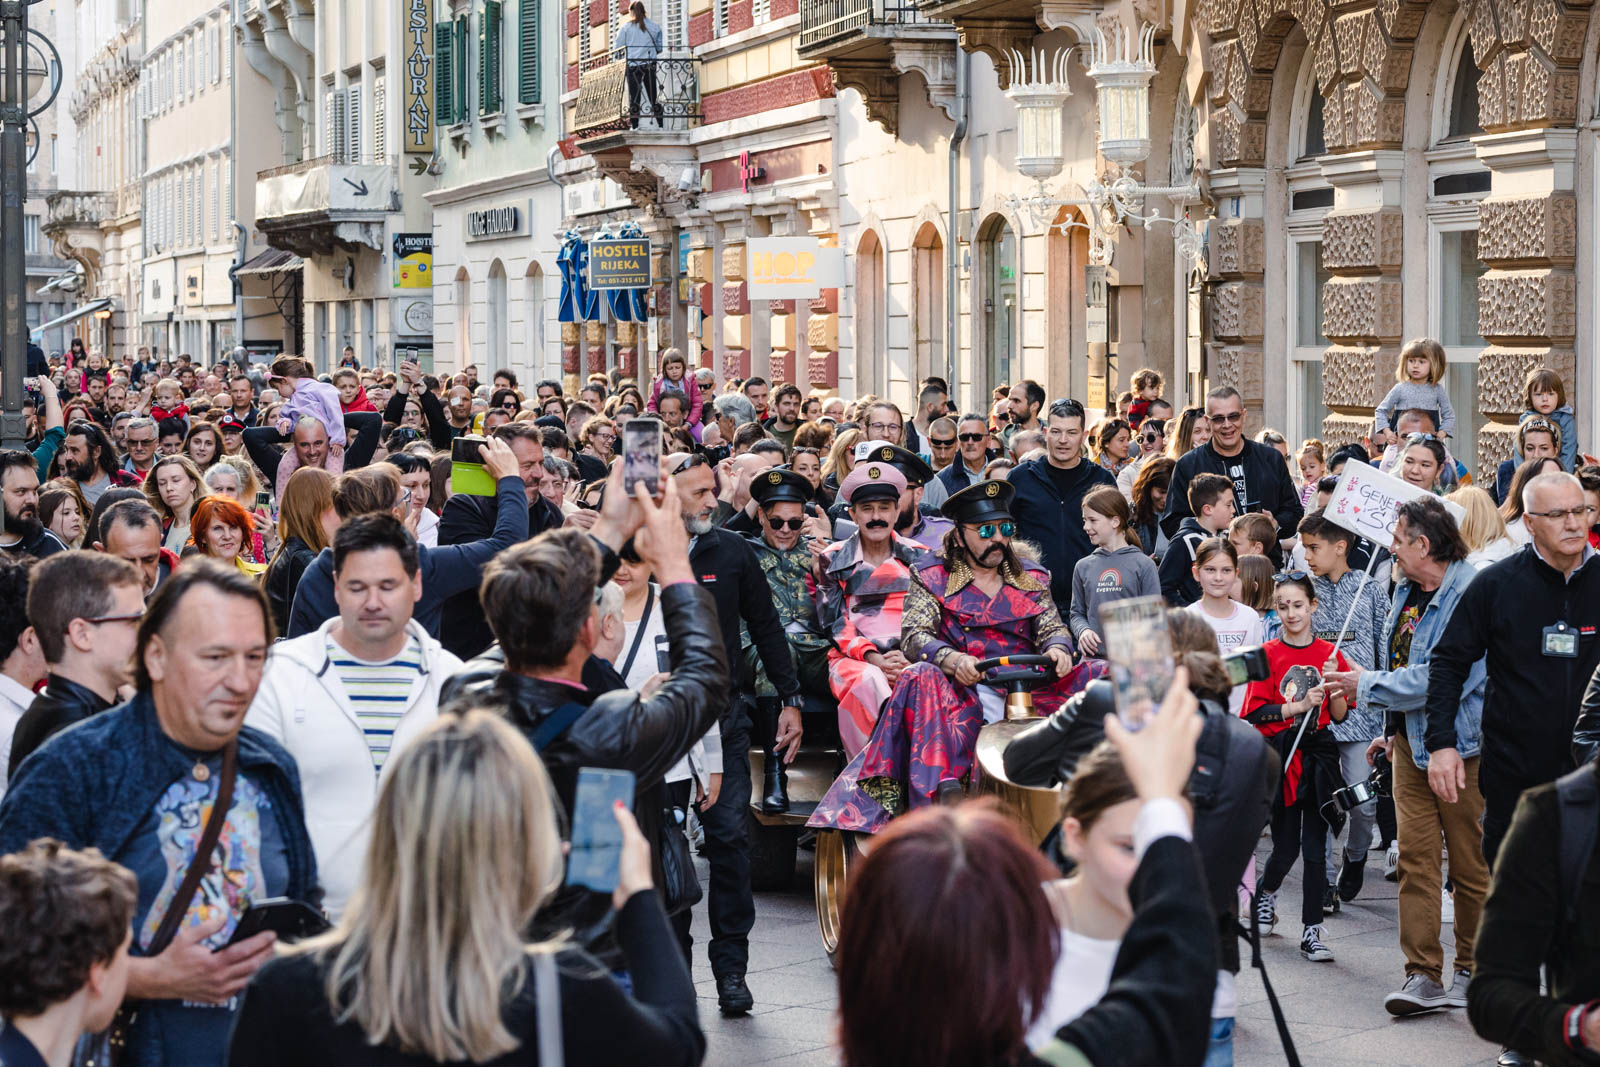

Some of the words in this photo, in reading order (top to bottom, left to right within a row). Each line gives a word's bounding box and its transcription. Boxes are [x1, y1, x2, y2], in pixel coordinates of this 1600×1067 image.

[487, 206, 517, 234] HADDAD
[592, 244, 647, 258] HOSTEL
[600, 260, 640, 271] RIJEKA
[752, 251, 815, 277] HOP
[1216, 634, 1242, 644] UESS
